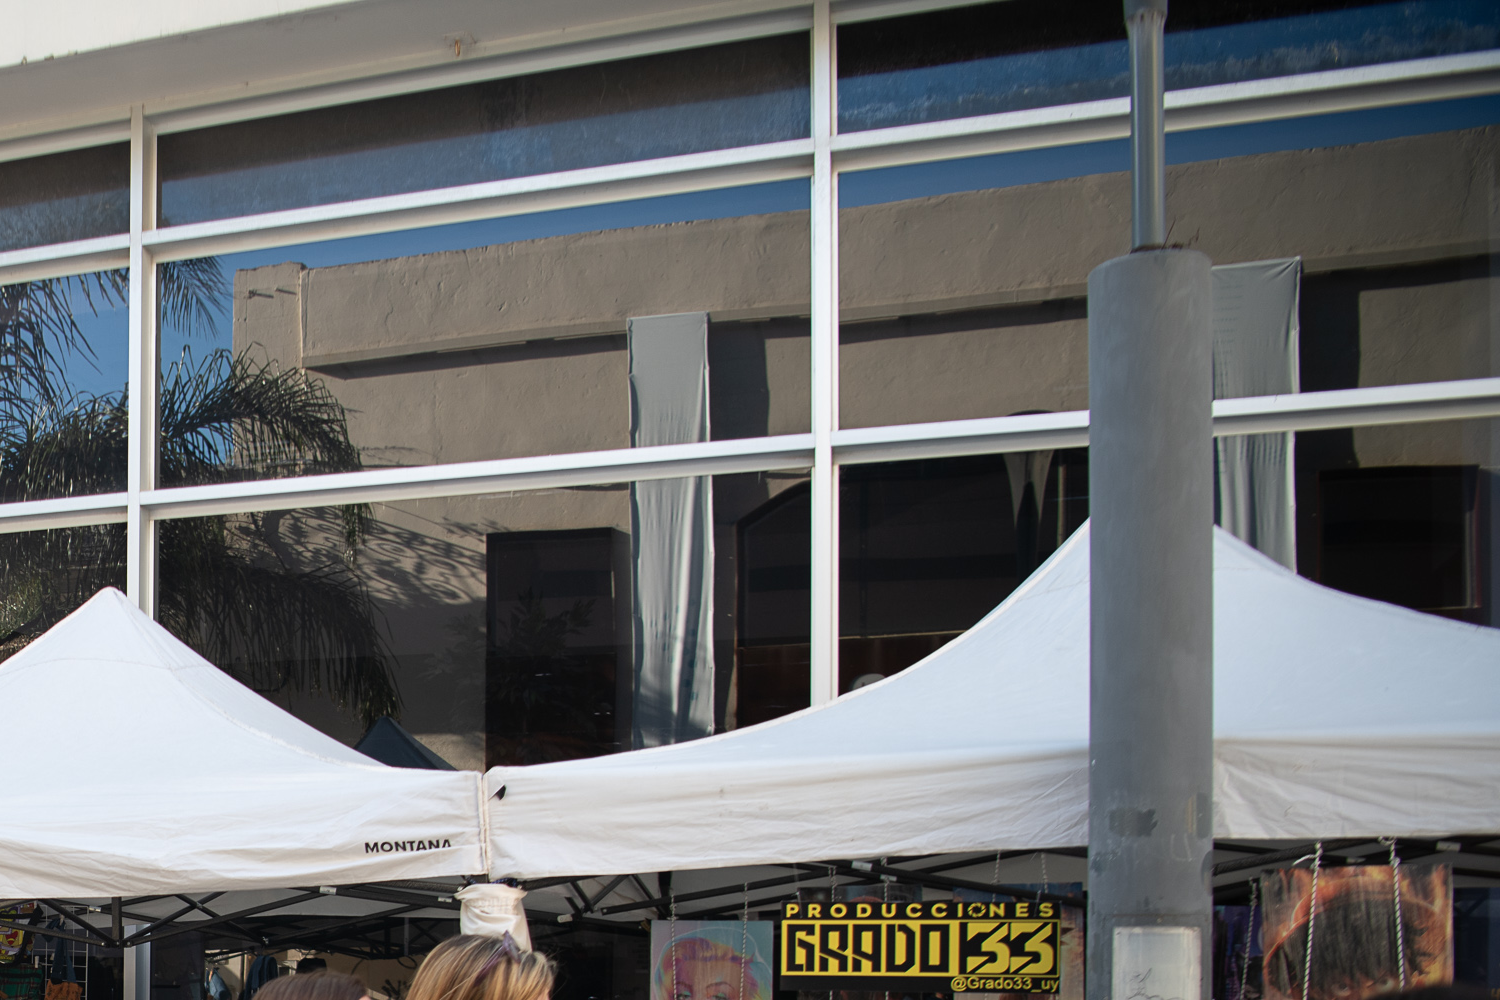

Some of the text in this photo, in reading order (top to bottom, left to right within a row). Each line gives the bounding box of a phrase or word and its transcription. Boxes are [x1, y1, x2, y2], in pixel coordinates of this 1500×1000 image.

[364, 839, 452, 854] MONTANA
[785, 902, 1054, 918] PRODUCCIONES
[786, 921, 1054, 974] GRADO 33
[950, 976, 1060, 993] @Grado33_uy
